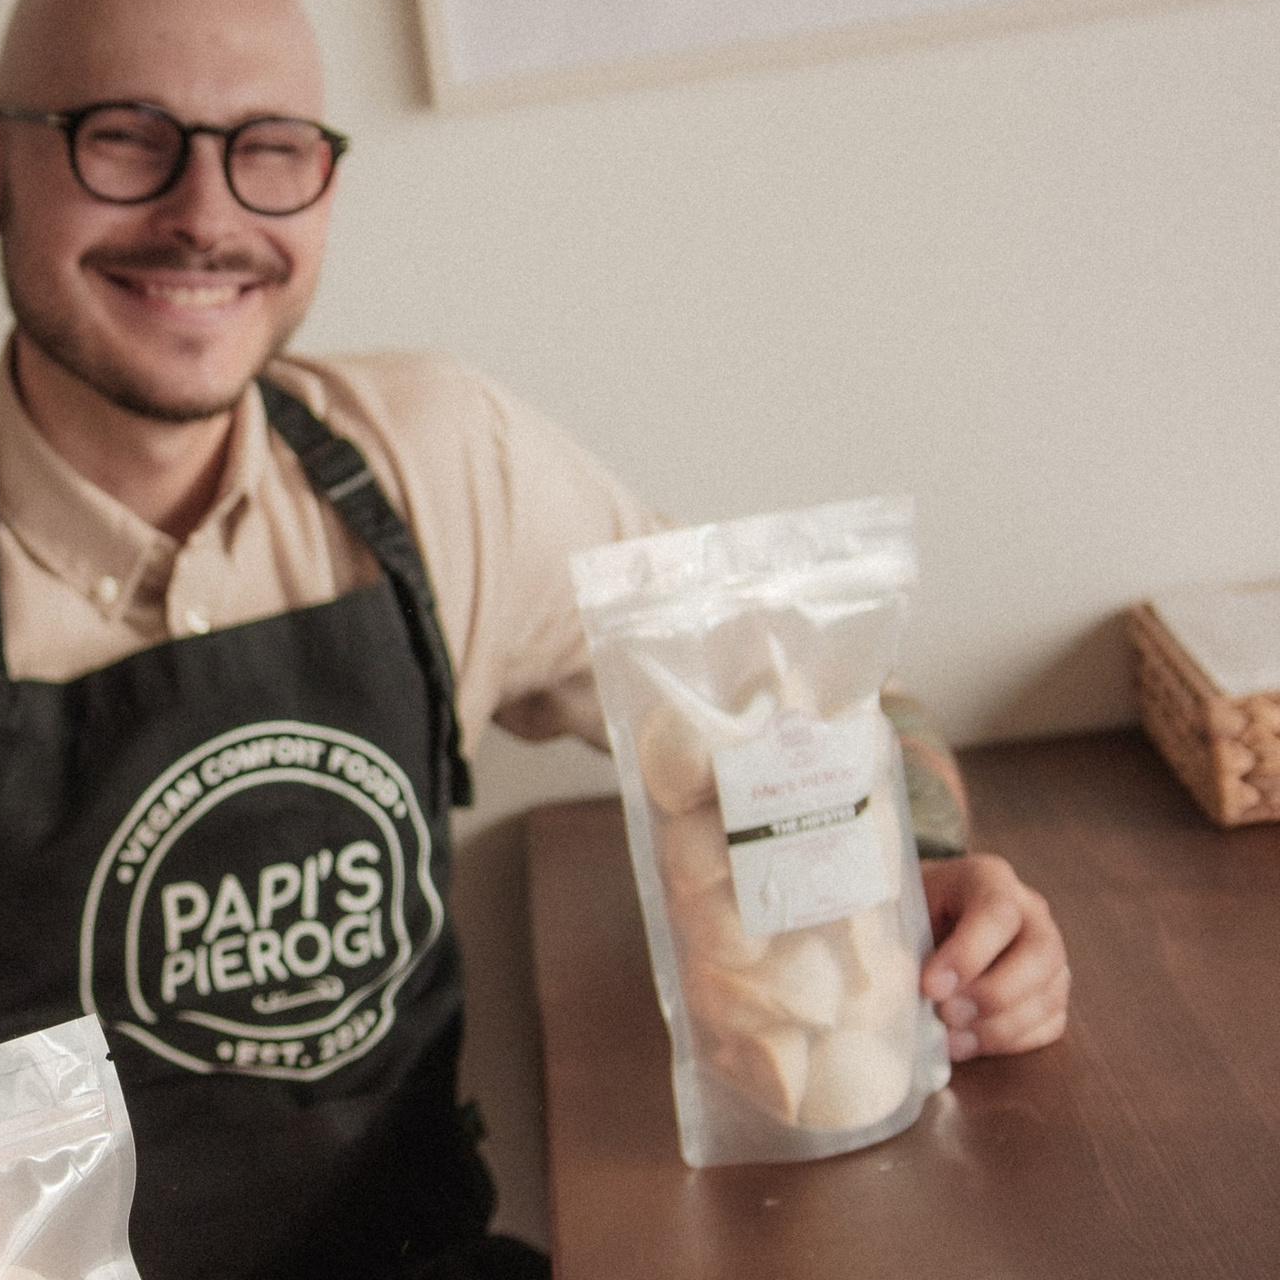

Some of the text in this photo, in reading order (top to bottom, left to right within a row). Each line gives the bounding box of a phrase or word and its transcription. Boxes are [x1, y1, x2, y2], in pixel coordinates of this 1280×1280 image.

[118, 736, 401, 864] VEGAN COMFORT FOOD
[161, 839, 384, 953] PAPI'S
[161, 907, 386, 1004] PIEROGI
